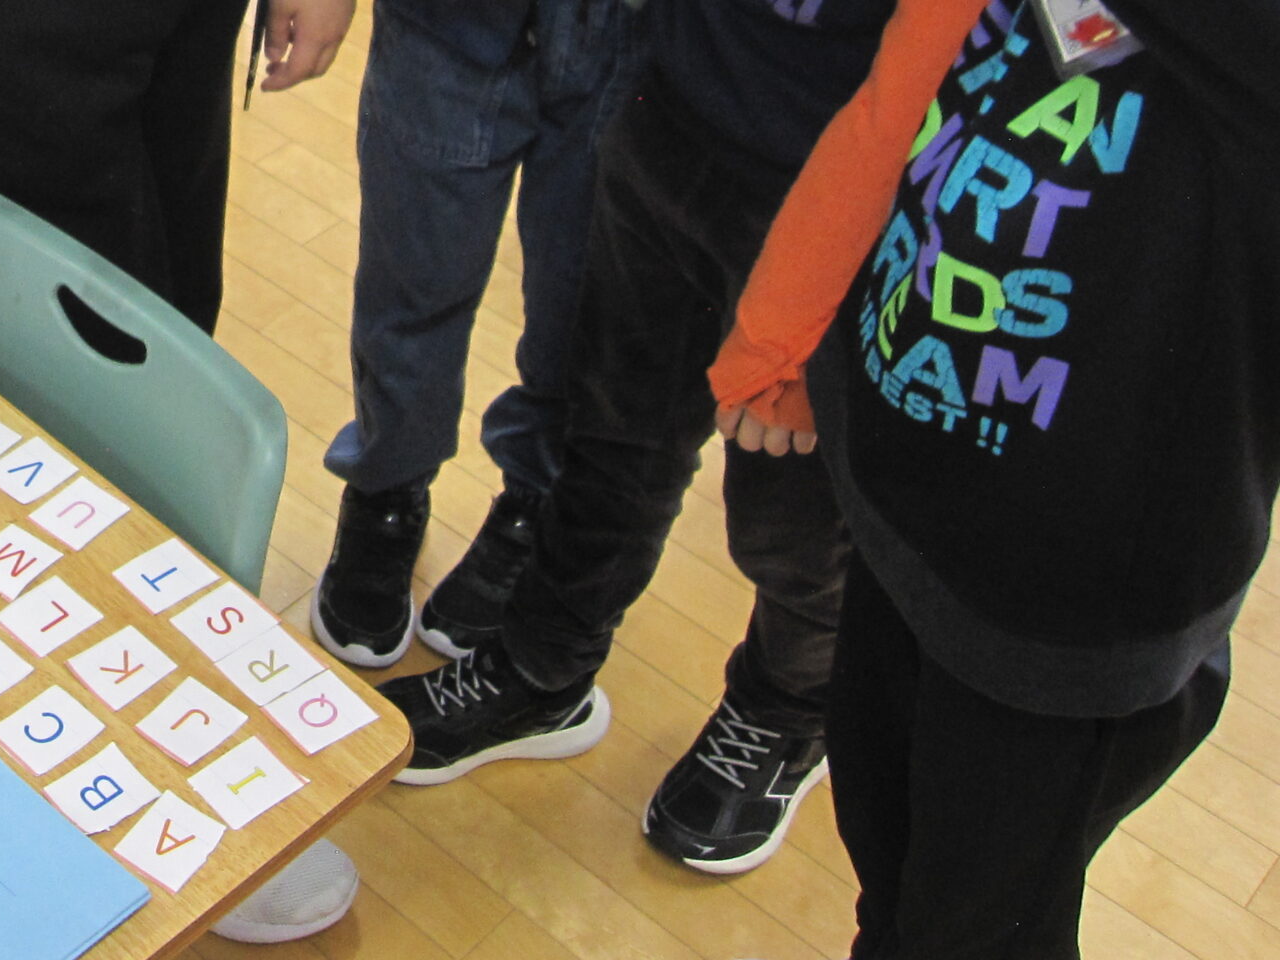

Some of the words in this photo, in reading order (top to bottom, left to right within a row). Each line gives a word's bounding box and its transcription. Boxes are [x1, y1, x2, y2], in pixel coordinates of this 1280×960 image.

[8, 461, 45, 487] V
[56, 500, 97, 529] U
[141, 567, 178, 593] T
[41, 600, 69, 634] L
[207, 607, 245, 636] S
[100, 651, 144, 685] K
[247, 650, 290, 682] R
[171, 709, 211, 731] J
[298, 694, 337, 727] Q
[23, 711, 65, 744] C
[79, 775, 125, 811] B
[228, 767, 267, 795] I
[156, 819, 196, 856] A
